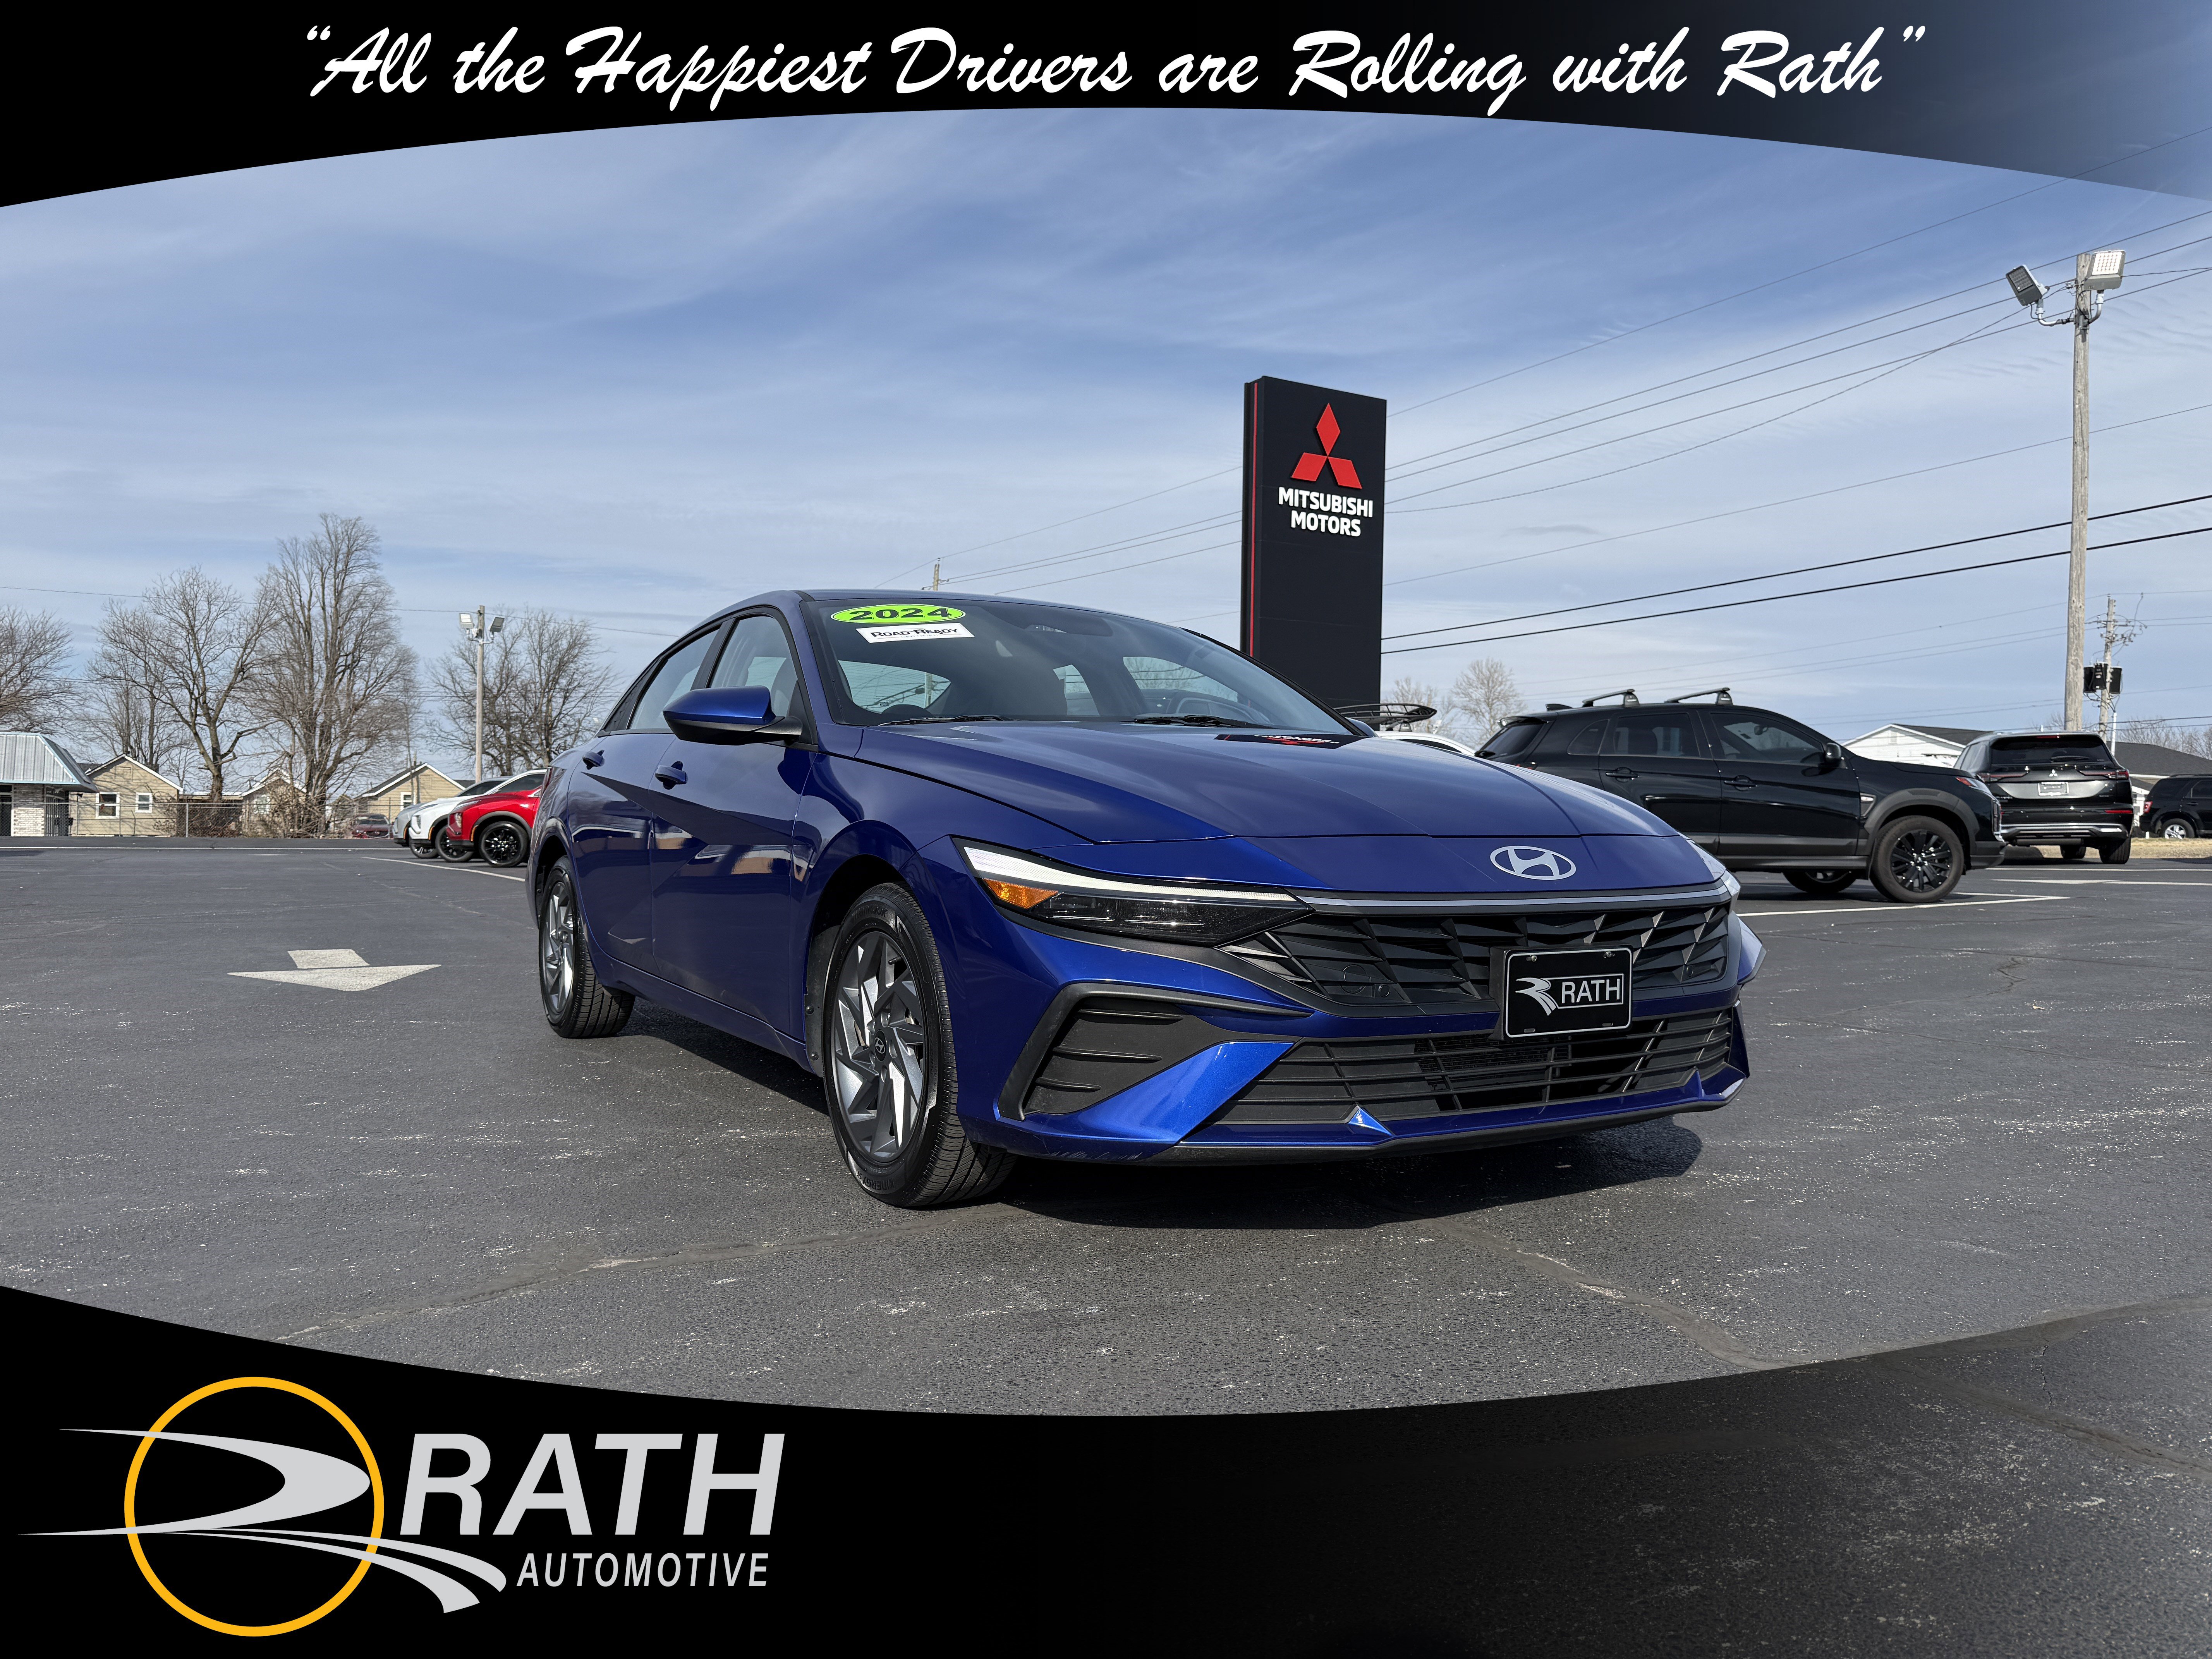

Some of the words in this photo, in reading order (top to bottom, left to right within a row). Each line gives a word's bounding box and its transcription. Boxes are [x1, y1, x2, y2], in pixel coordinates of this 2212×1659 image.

[1279, 487, 1373, 517] MITSUBISHI
[1291, 510, 1361, 537] MOTORS
[849, 608, 952, 620] 2024
[1561, 979, 1620, 1004] RATH
